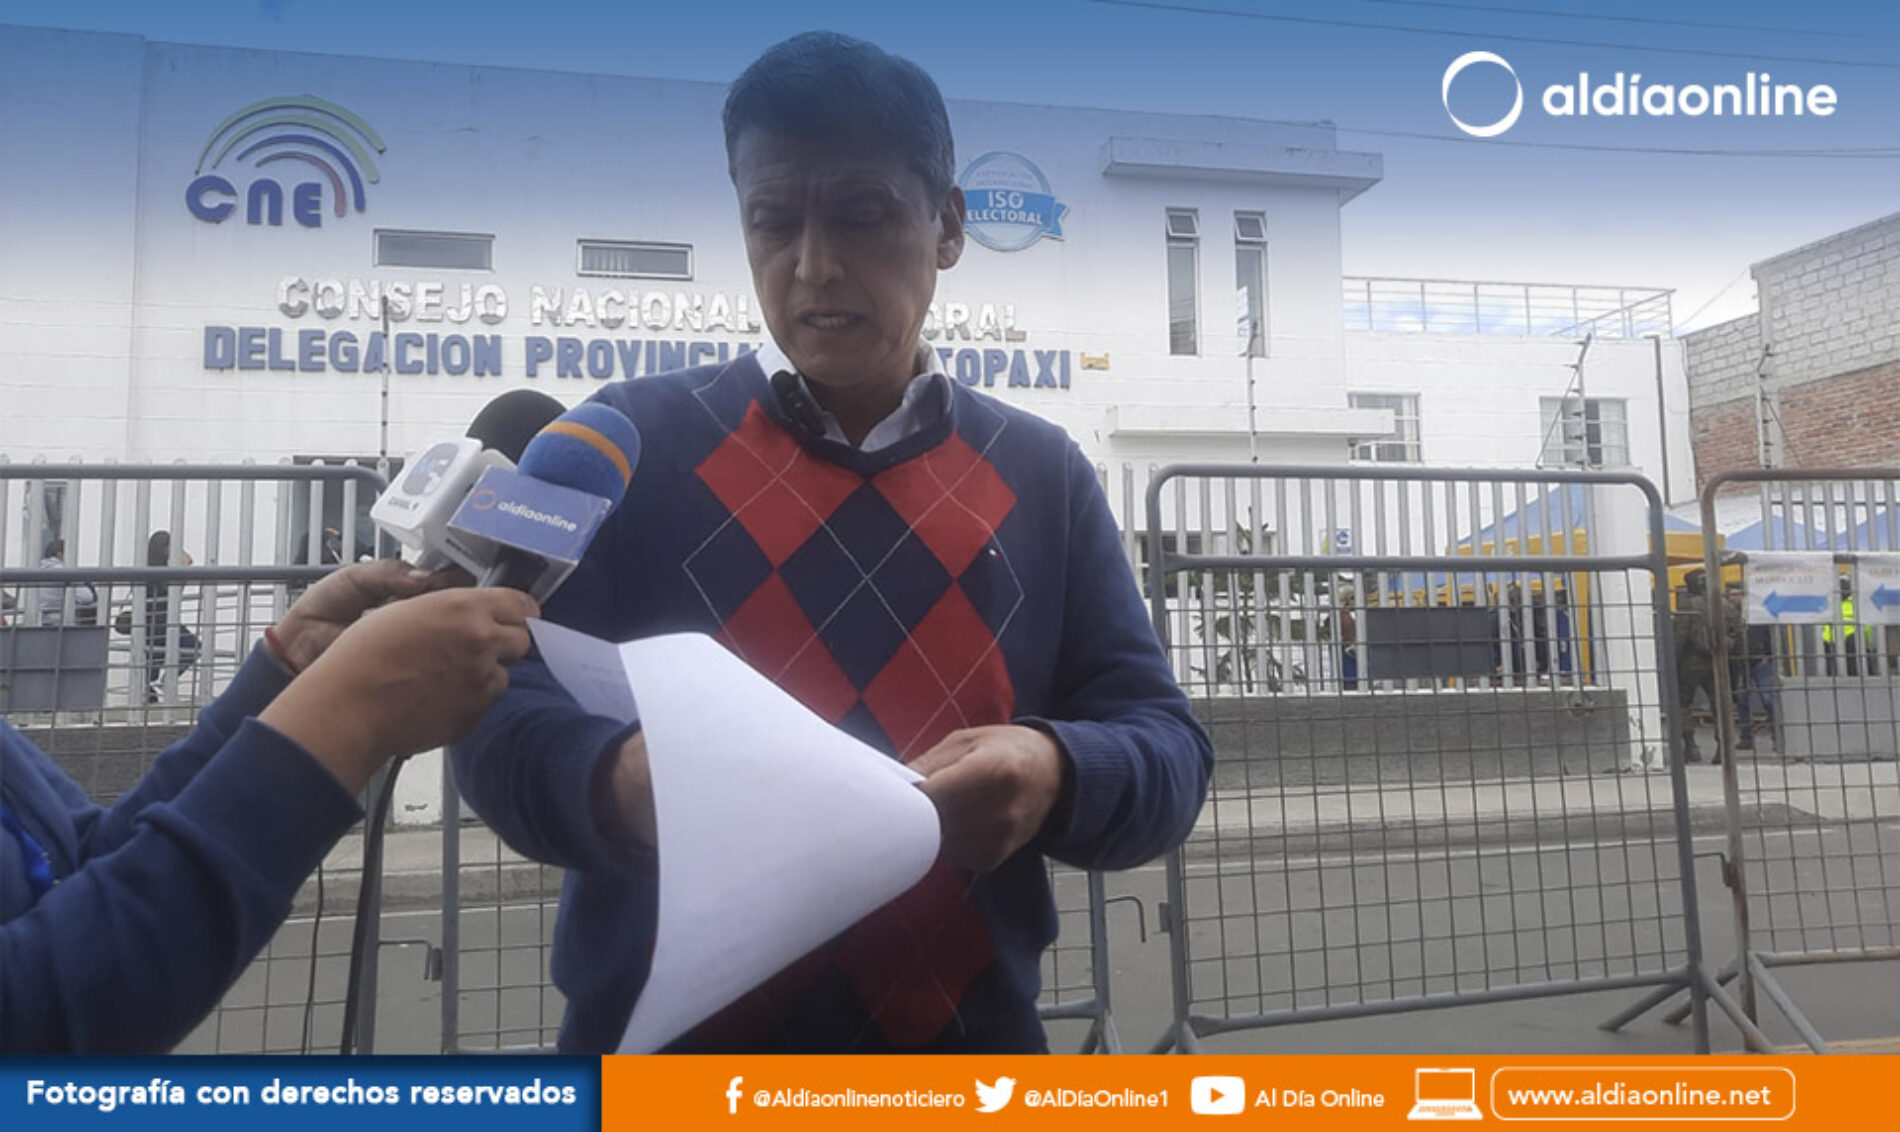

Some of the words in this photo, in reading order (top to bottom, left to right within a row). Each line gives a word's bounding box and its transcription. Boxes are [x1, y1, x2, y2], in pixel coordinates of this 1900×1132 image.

[966, 209, 1043, 225] ELECTORAL
[987, 191, 1025, 209] ISO
[277, 275, 509, 325] CONSEJO
[531, 284, 761, 333] NACIONAL
[921, 302, 1027, 342] ORAL
[204, 326, 502, 375] DELEGACION
[525, 334, 763, 380] PROVINCI
